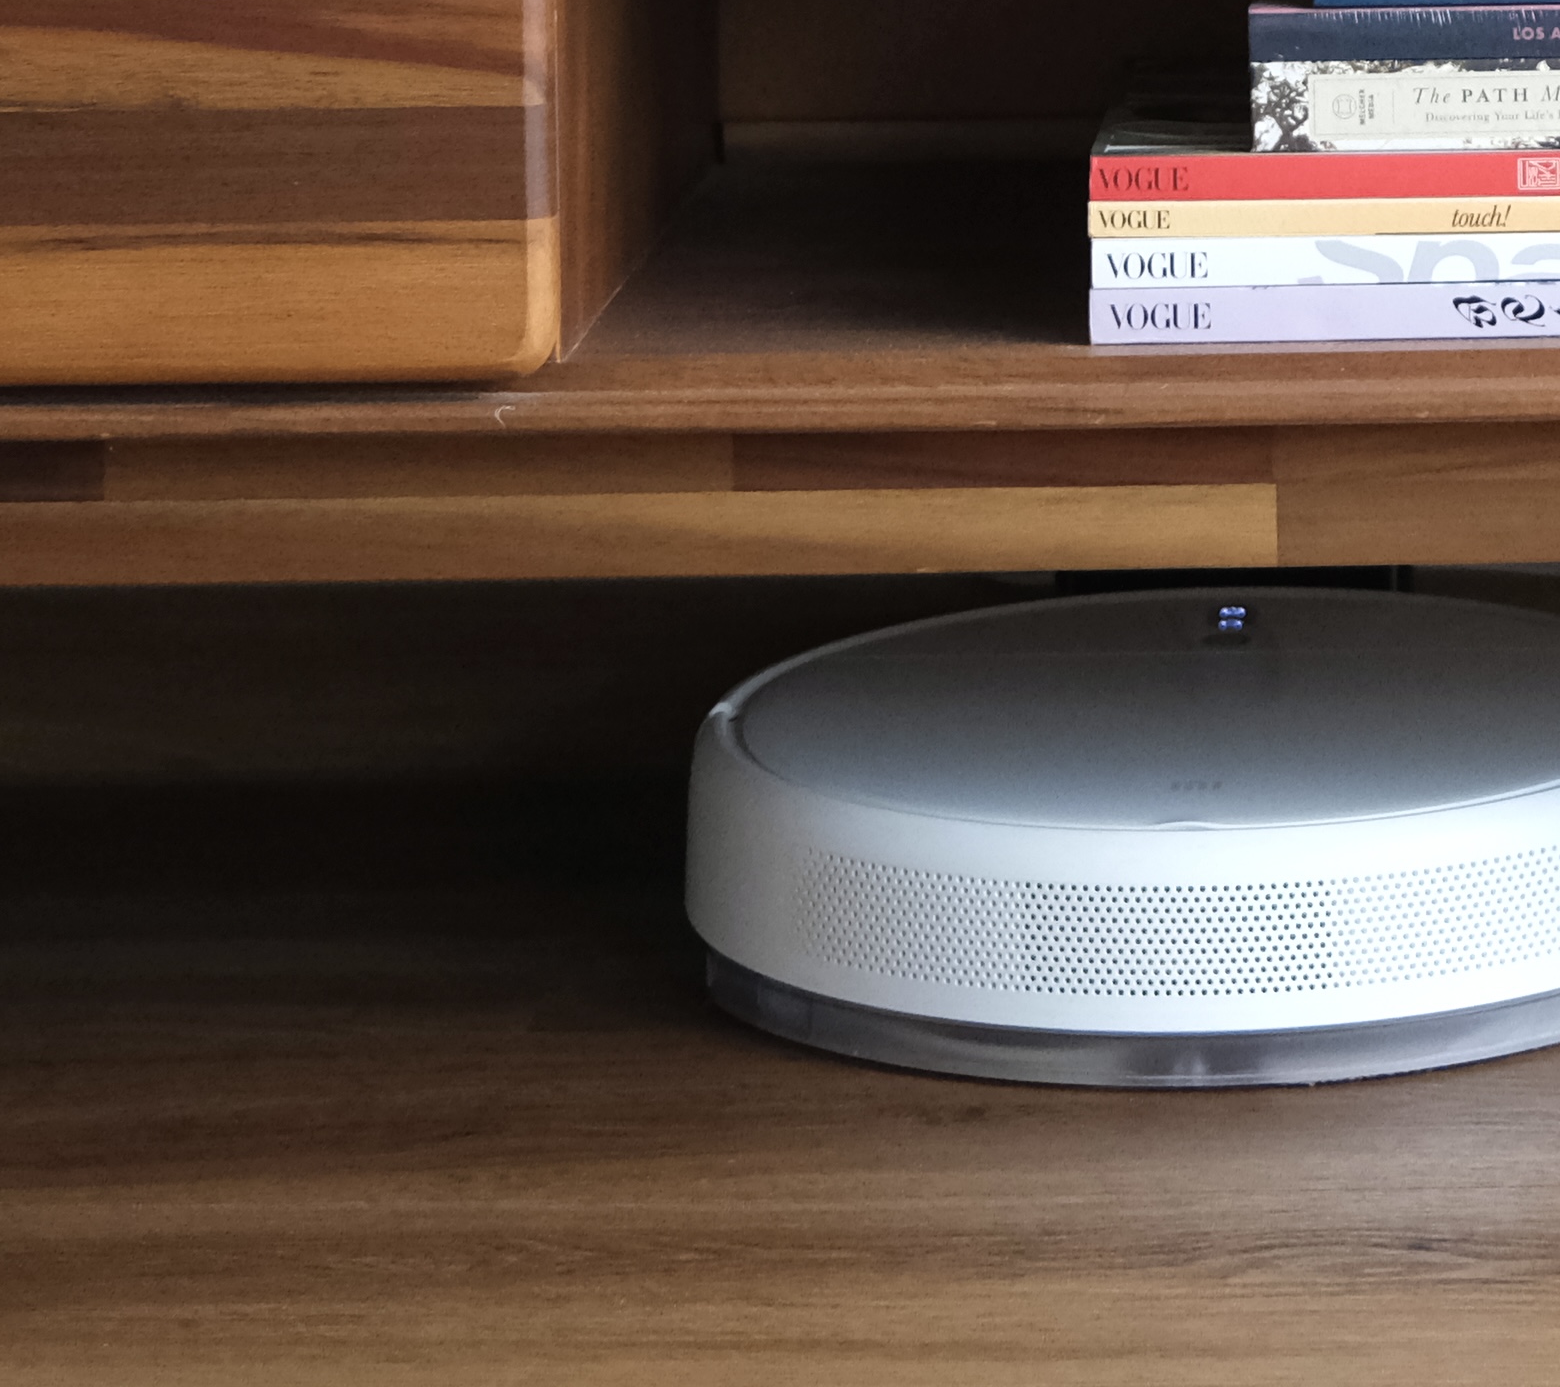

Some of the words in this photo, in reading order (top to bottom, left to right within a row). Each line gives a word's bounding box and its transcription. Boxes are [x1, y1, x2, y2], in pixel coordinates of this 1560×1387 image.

[1512, 26, 1545, 41] LOS
[1413, 86, 1452, 105] The
[1461, 86, 1529, 104] PATH
[1425, 111, 1490, 124] Discovering
[1493, 111, 1520, 122] Your
[1523, 110, 1554, 121] Life's
[1099, 166, 1189, 192] VOGUE
[1098, 210, 1171, 230] VOGUE
[1451, 204, 1511, 228] touch!
[1106, 251, 1209, 280] VOGUE
[1110, 302, 1212, 331] VOGUE
